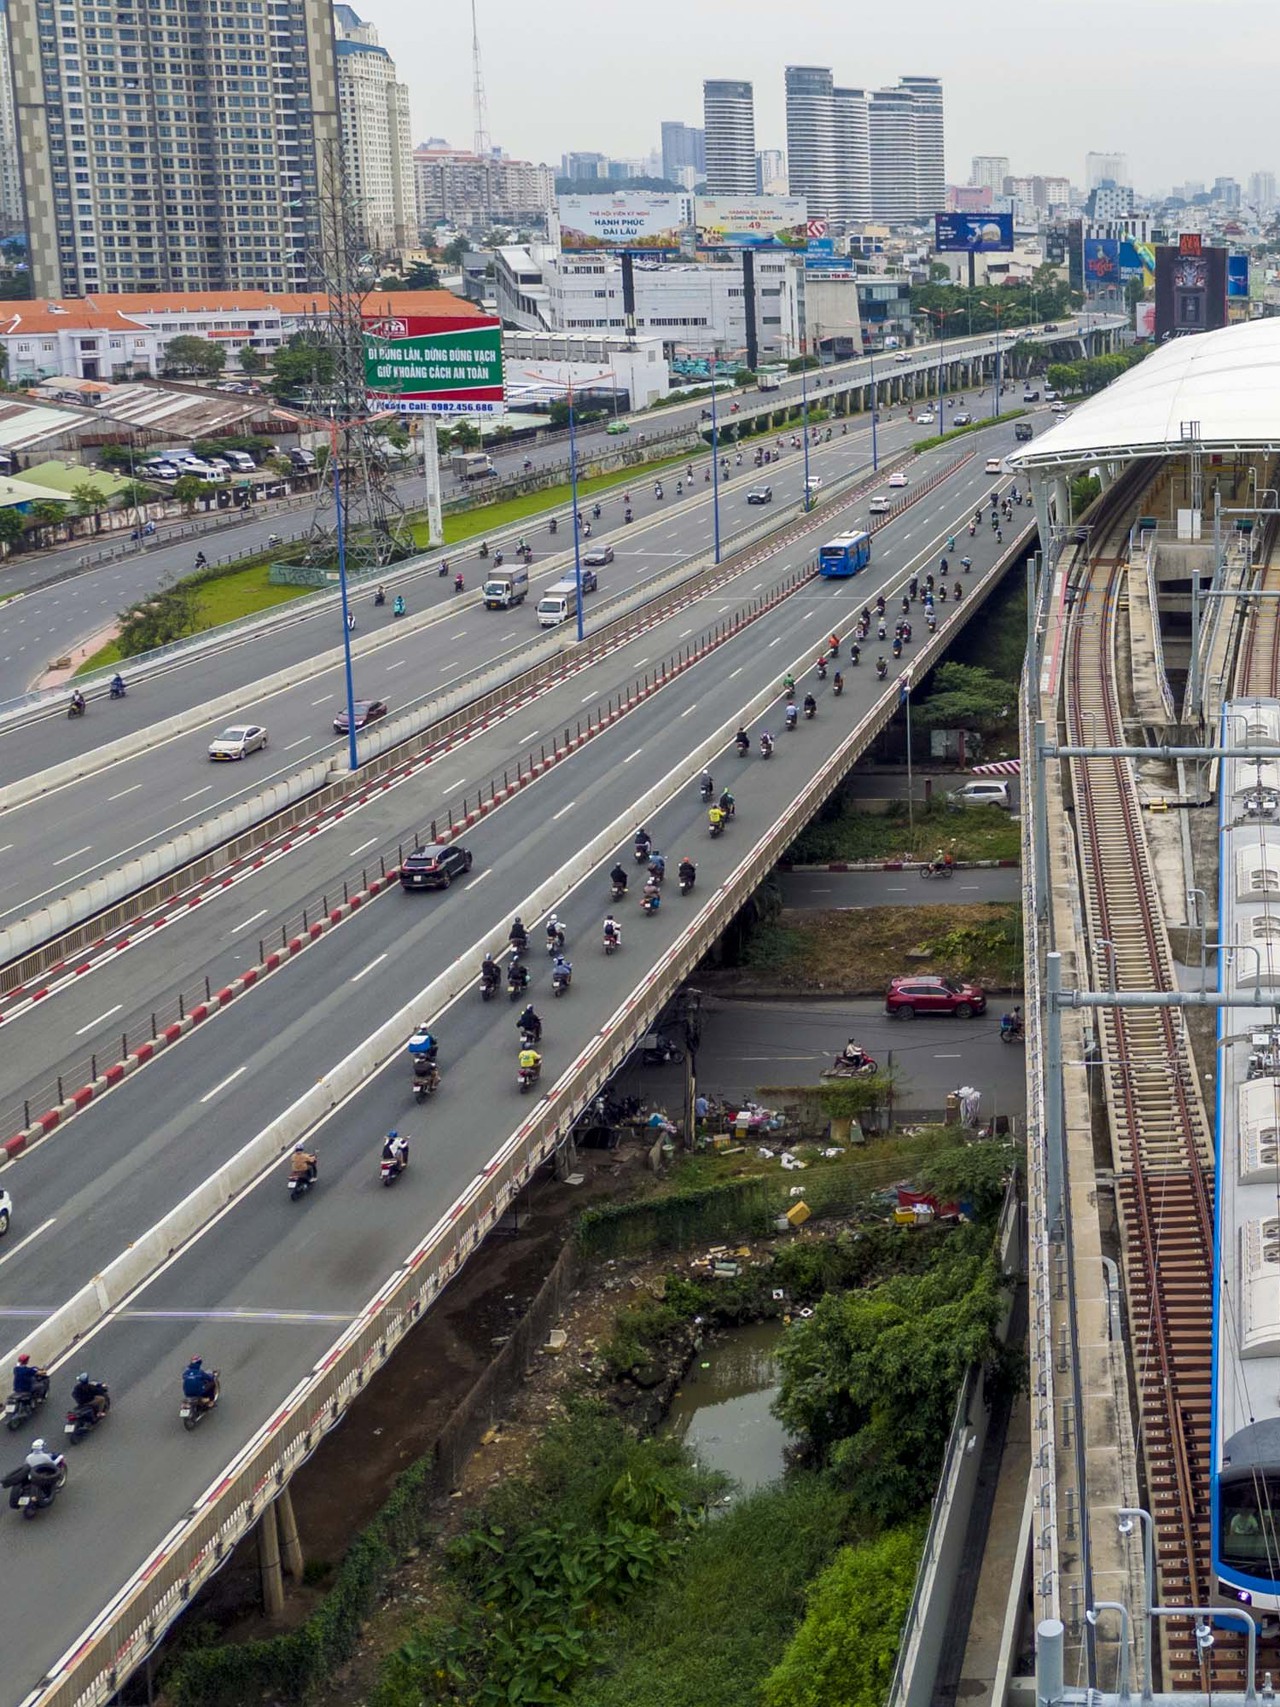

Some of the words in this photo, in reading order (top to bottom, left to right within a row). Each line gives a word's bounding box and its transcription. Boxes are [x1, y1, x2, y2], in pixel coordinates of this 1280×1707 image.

[473, 349, 497, 364] VẠCH
[429, 364, 452, 379] CÁCH
[453, 366, 465, 379] AN
[466, 364, 489, 379] TOÀN
